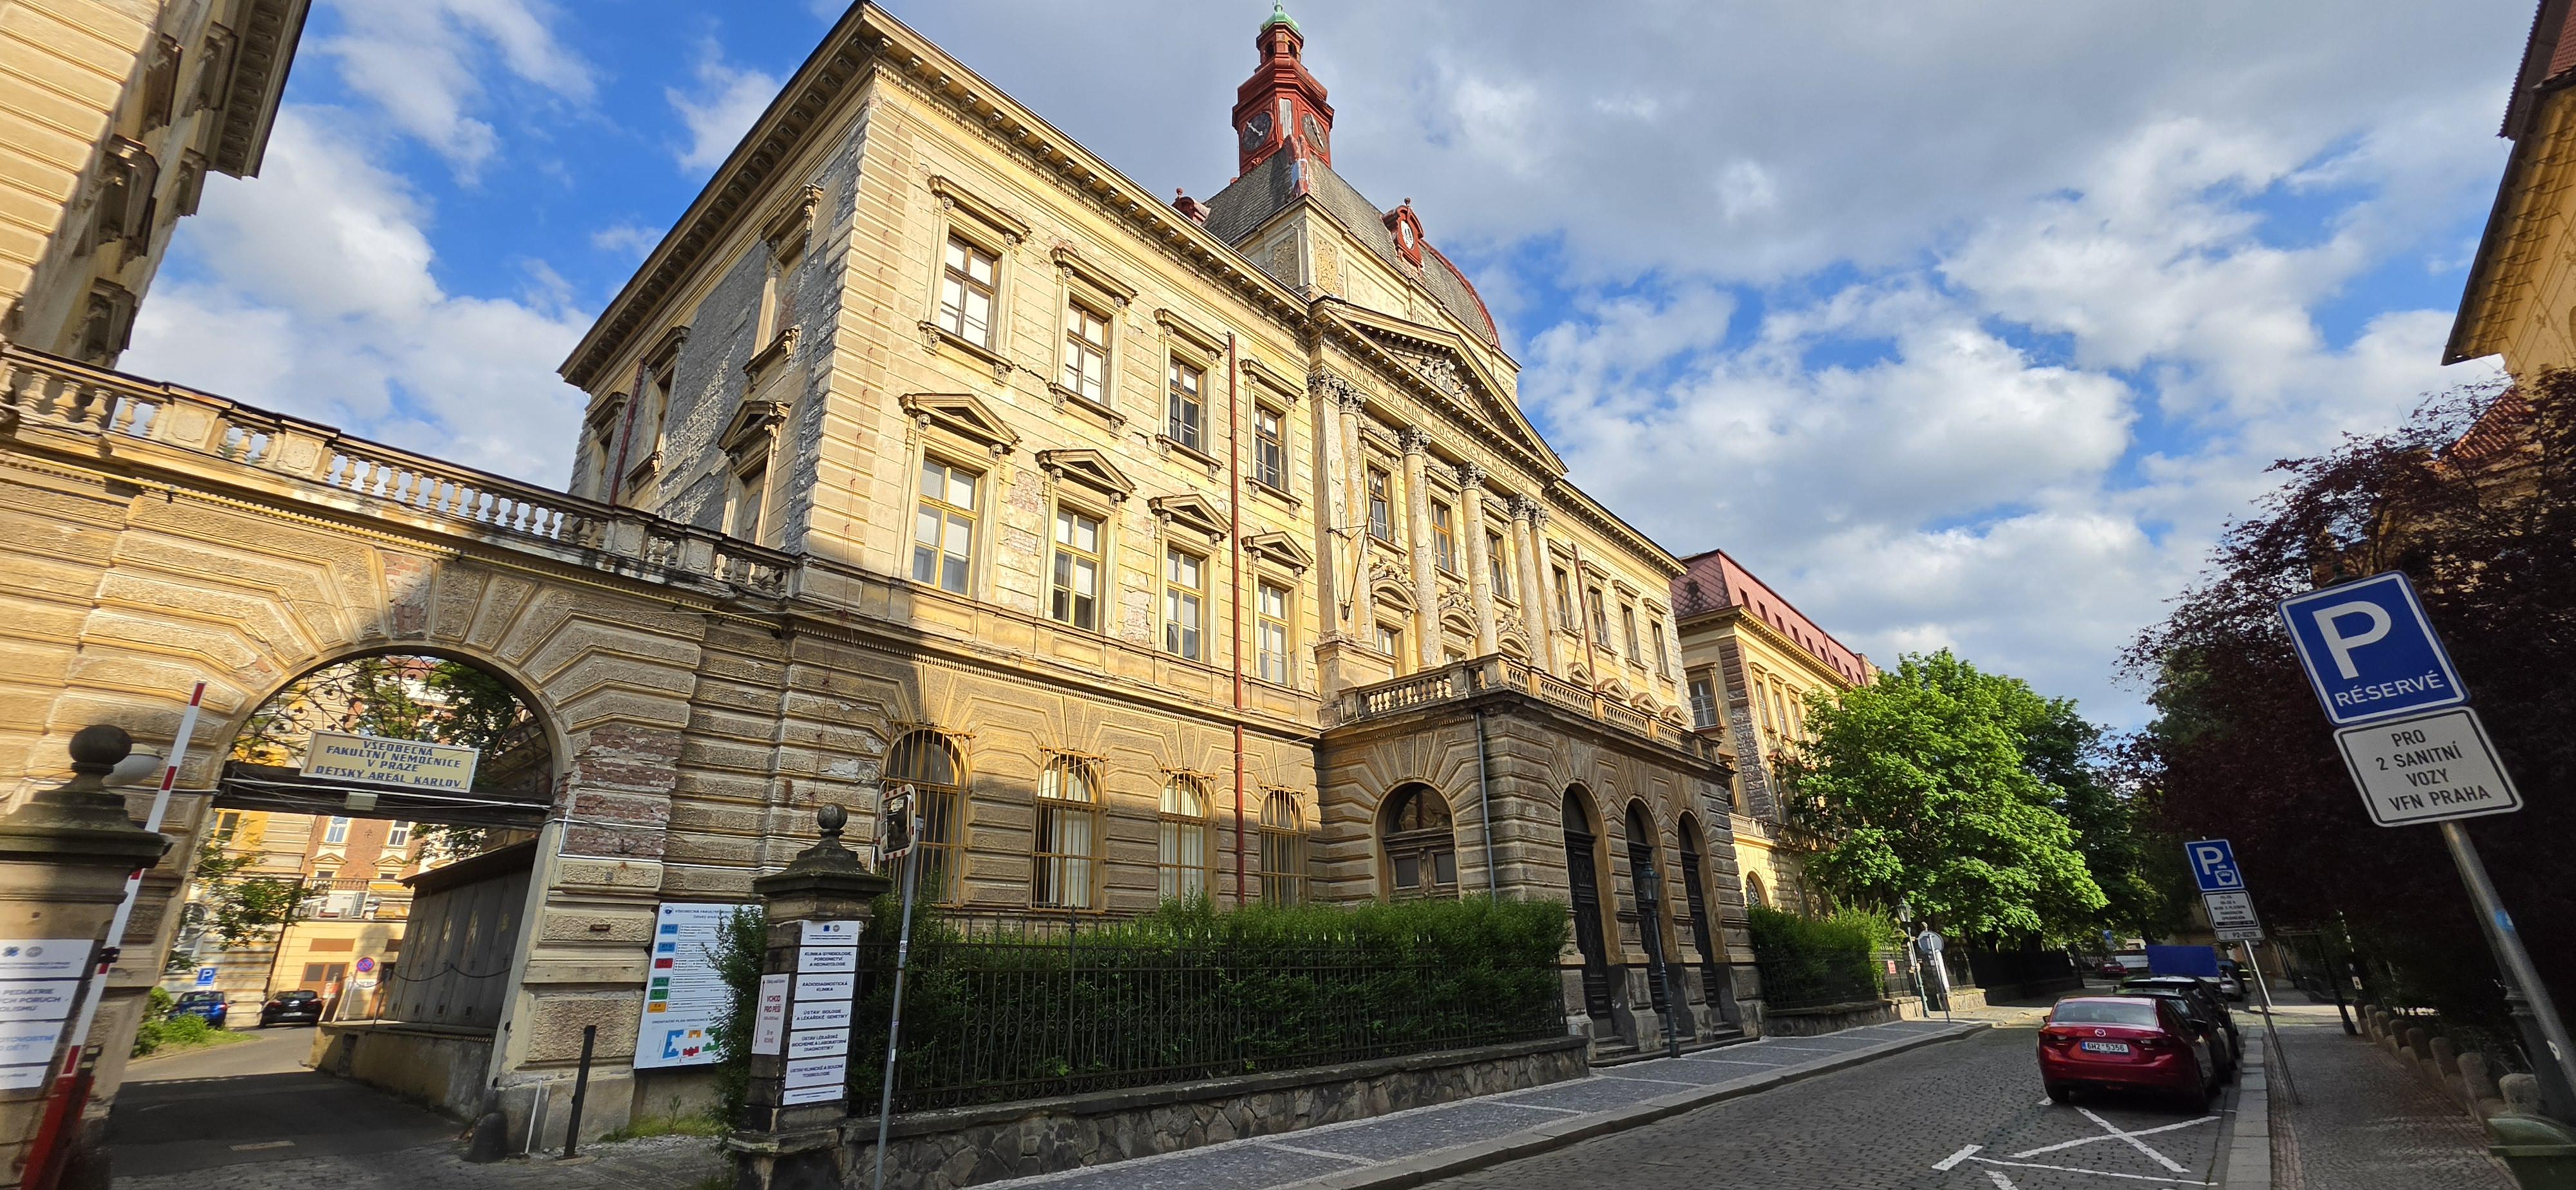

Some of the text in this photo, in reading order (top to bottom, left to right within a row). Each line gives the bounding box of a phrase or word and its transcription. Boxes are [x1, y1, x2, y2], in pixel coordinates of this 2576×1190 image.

[1347, 366, 1378, 392] ANNO
[1388, 390, 1424, 422] DOMINI
[2312, 601, 2391, 679] P
[2334, 670, 2445, 706] RÉSERVÉ
[2391, 729, 2426, 747] PRO
[326, 746, 462, 768] FAKULTNÍ NEMOCNICE
[380, 761, 419, 772] PRAZE
[2376, 741, 2463, 771] 2 SANITNÍ
[368, 772, 406, 782] AREÁL
[414, 776, 462, 788] KARLOV
[2405, 768, 2450, 787] VOZY
[2388, 785, 2492, 811] VFN PRAHA
[2196, 847, 2223, 874] P
[202, 968, 213, 979] P
